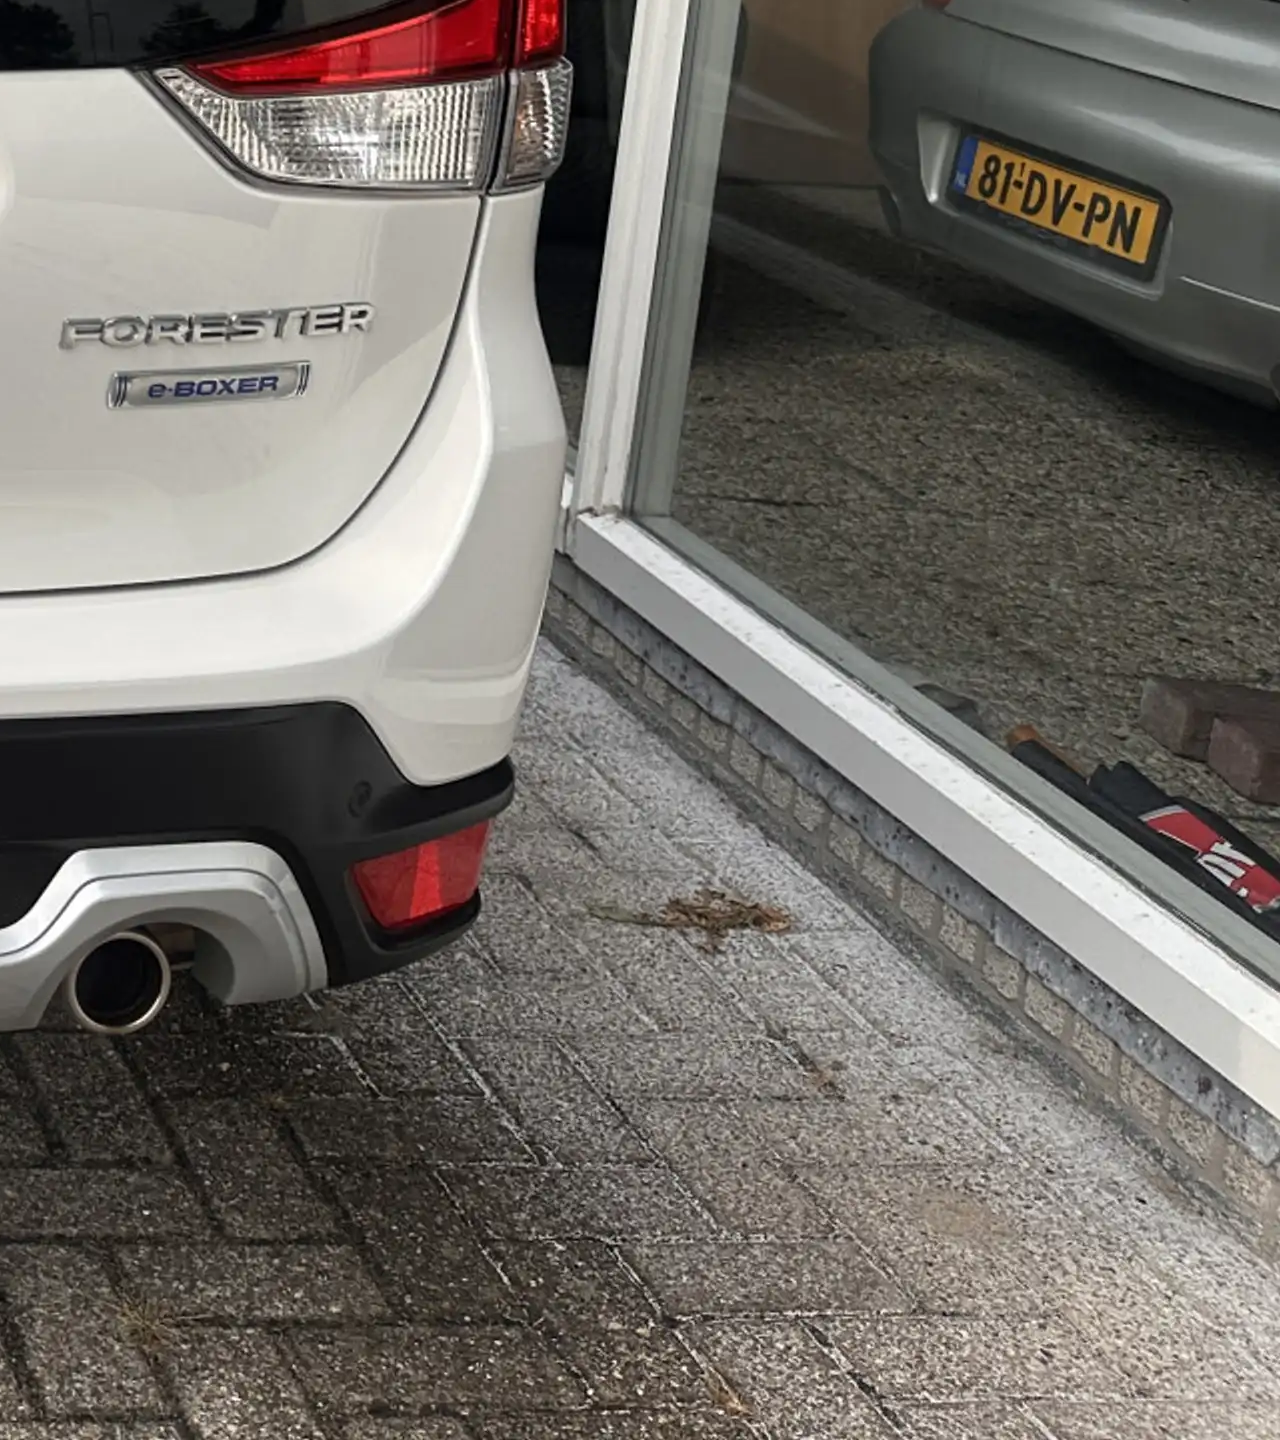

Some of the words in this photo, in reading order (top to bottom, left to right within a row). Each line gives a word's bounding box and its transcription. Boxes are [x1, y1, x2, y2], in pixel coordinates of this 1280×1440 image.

[977, 154, 1141, 253] 81-DV-PN
[58, 301, 376, 349] FORESTER
[148, 375, 280, 399] e-BOXER
